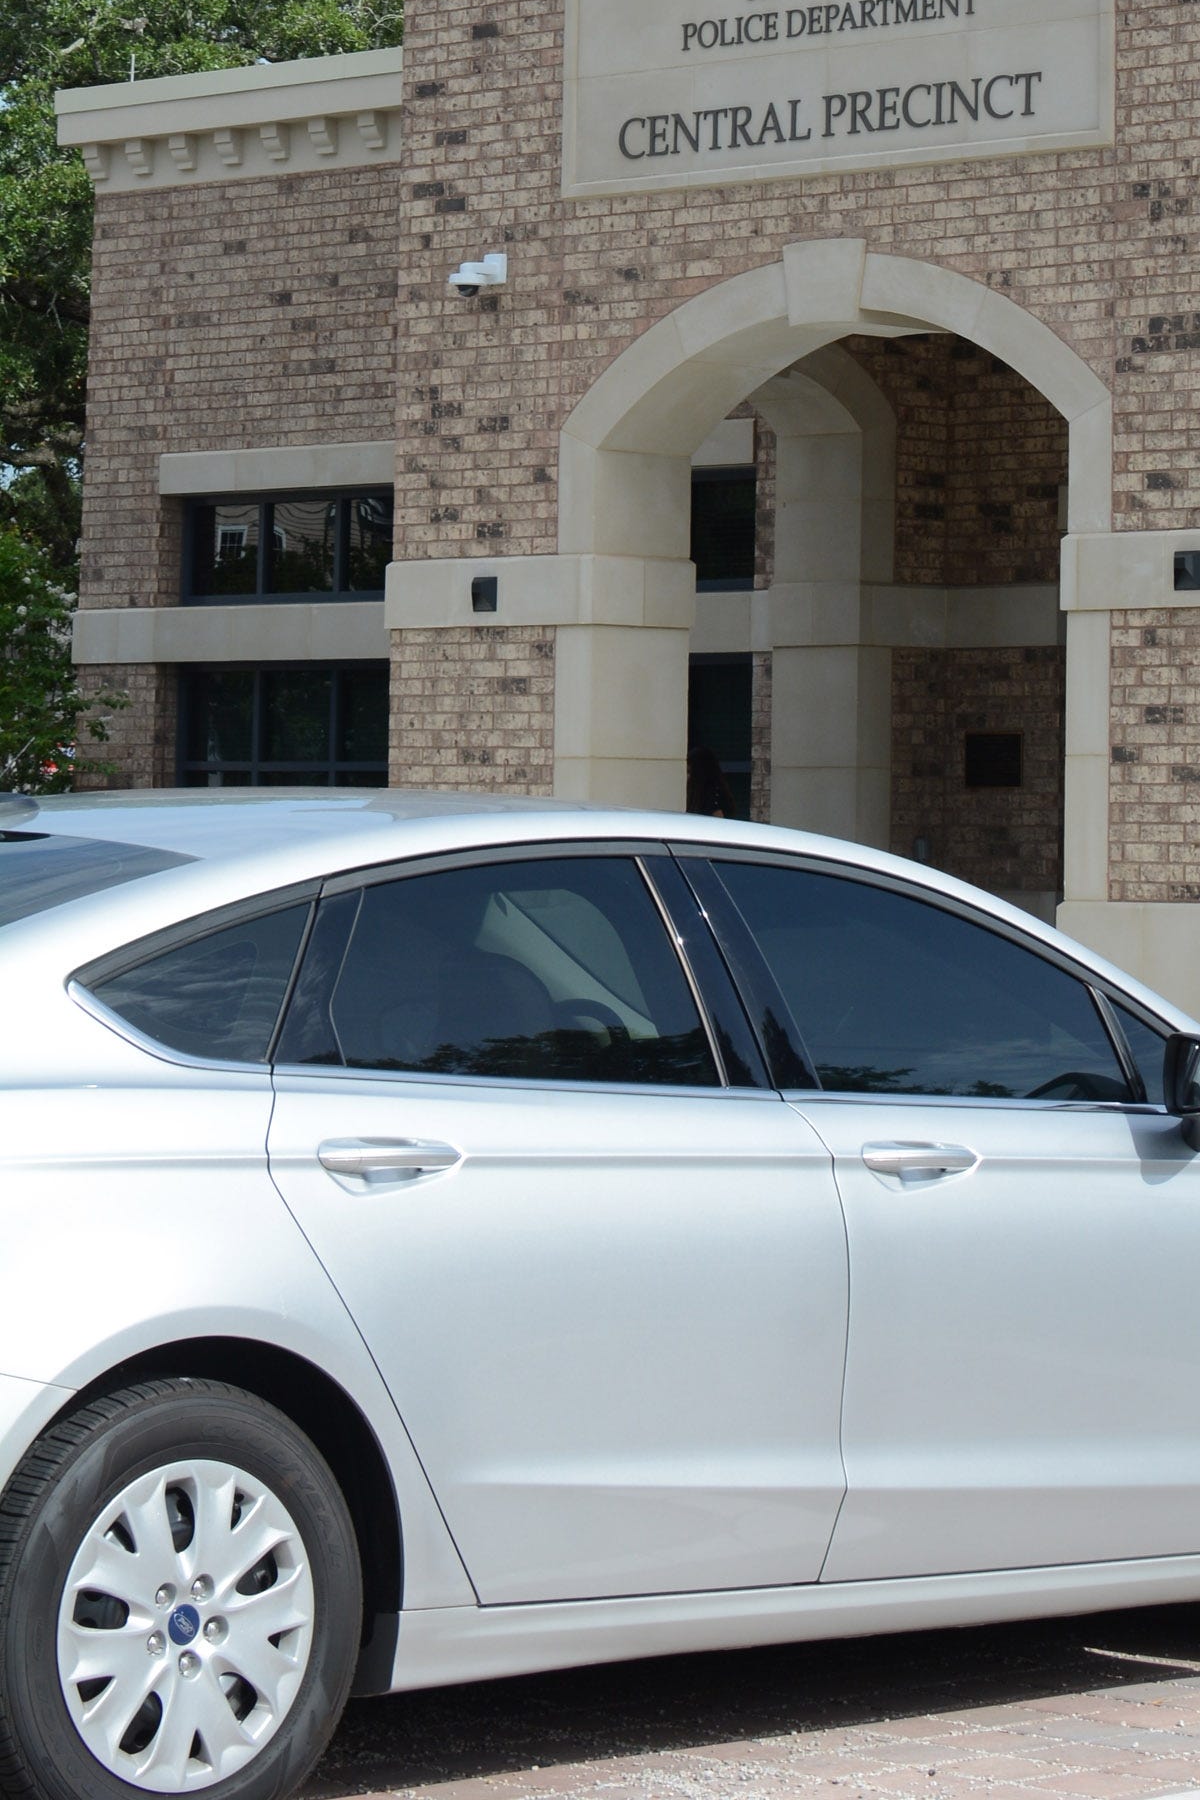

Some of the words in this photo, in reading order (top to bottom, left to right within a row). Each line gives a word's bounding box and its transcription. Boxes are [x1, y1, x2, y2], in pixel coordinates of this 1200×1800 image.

[681, 12, 779, 51] POLICE
[618, 99, 812, 160] CENTRAL
[821, 71, 1043, 138] PRECINCT
